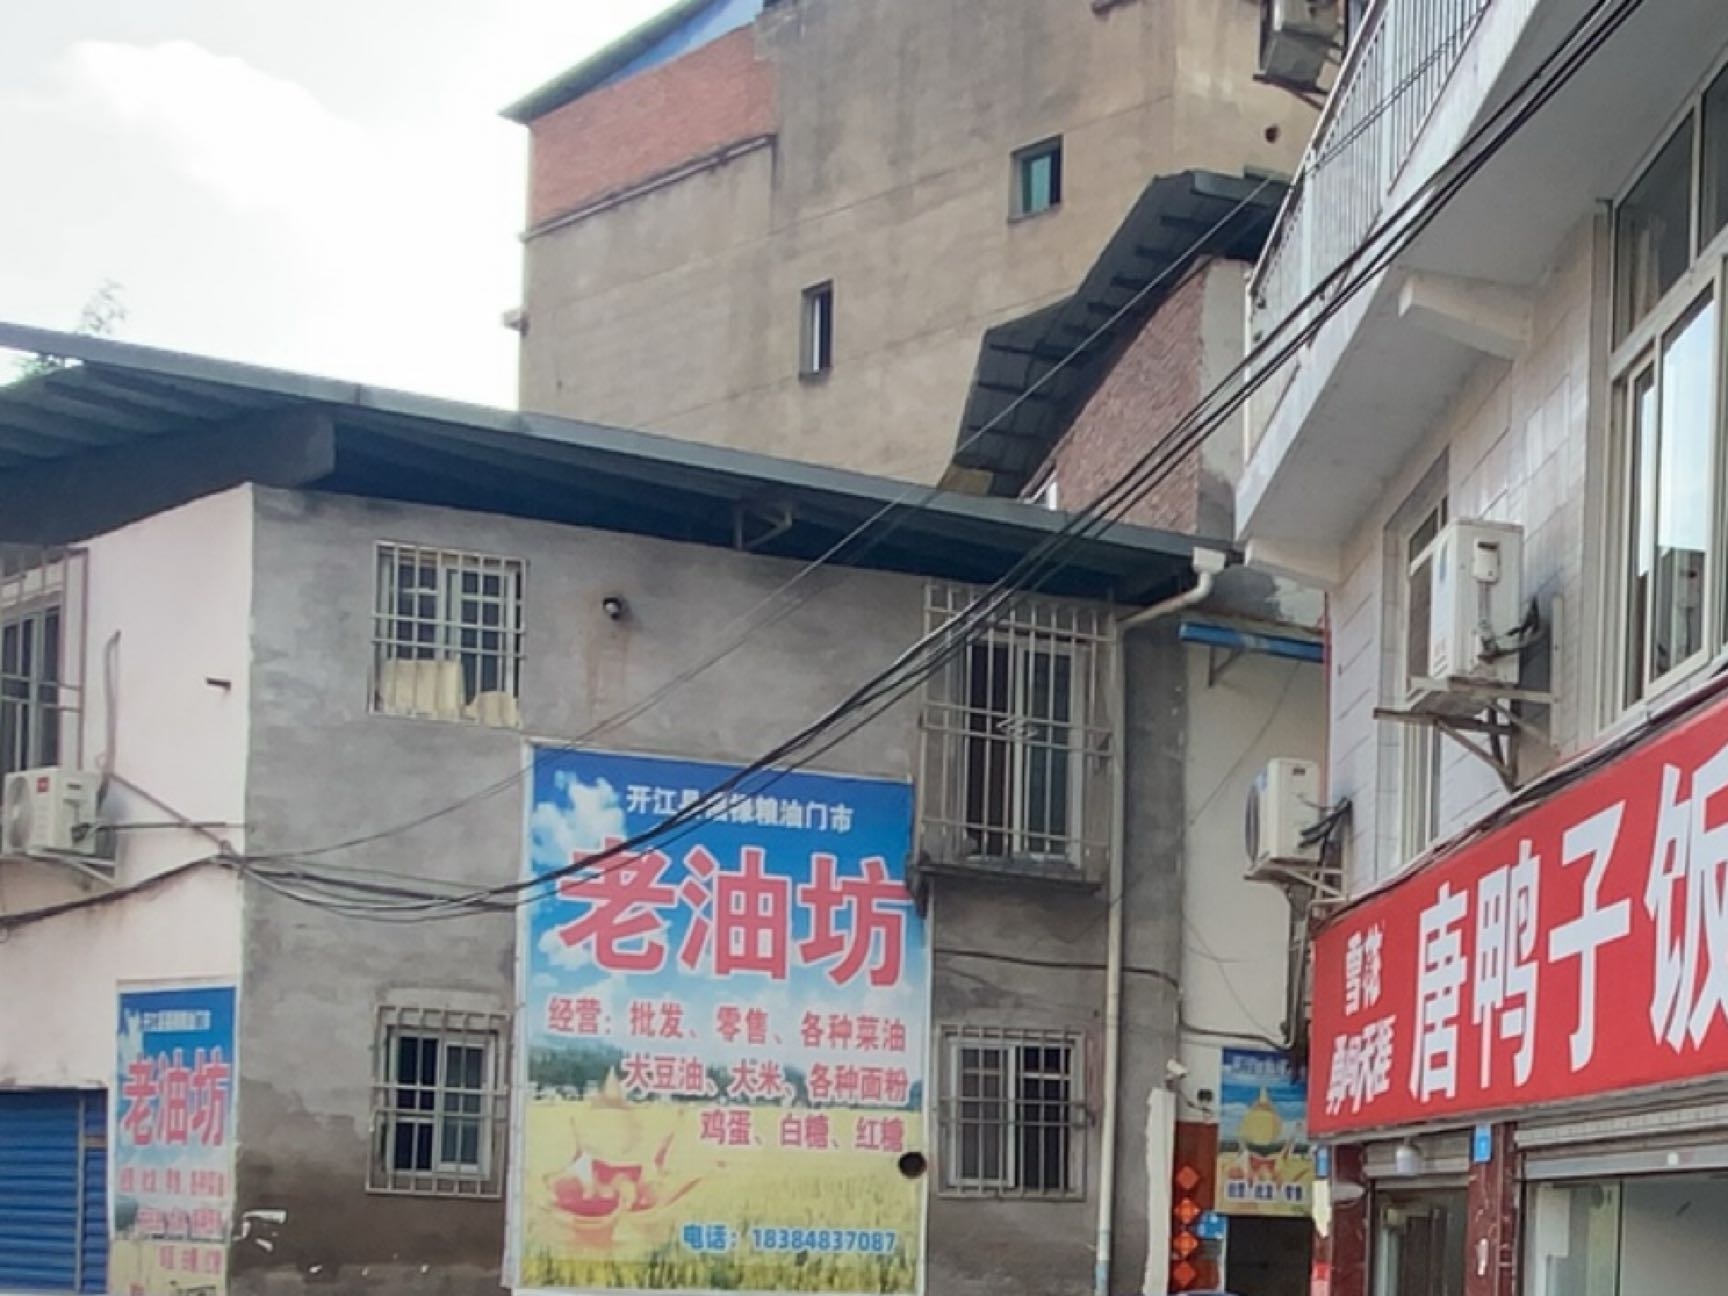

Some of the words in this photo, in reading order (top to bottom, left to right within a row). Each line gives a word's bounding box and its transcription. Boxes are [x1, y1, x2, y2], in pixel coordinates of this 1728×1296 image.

[555, 836, 913, 988] 老油坊
[121, 1046, 232, 1146] 老油坊
